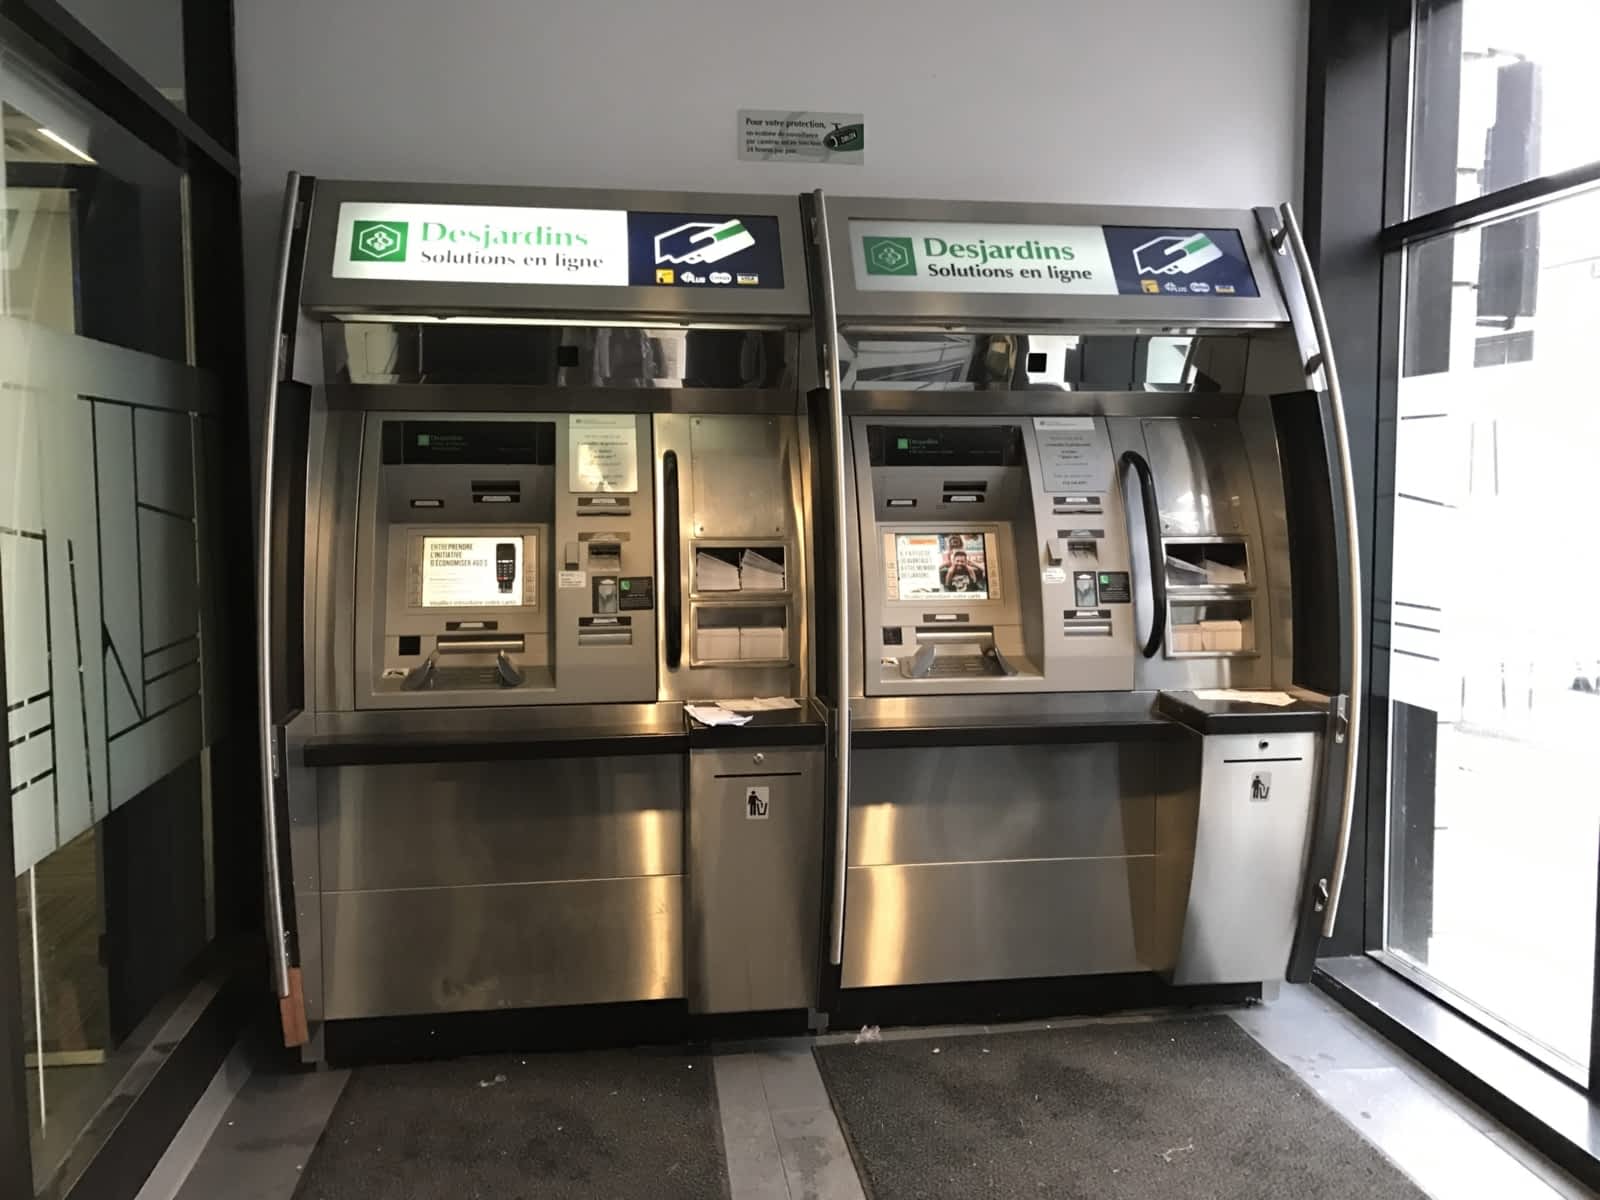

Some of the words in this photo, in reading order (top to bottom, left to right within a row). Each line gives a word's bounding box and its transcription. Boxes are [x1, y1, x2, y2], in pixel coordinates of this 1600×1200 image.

[422, 221, 589, 249] Desjardins
[420, 249, 516, 265] Solutions
[523, 255, 547, 267] en
[555, 252, 604, 272] ligne
[924, 237, 1076, 265] Desjardins
[927, 263, 1014, 279] Solutions
[1020, 269, 1042, 279] en
[1047, 265, 1094, 284] ligne
